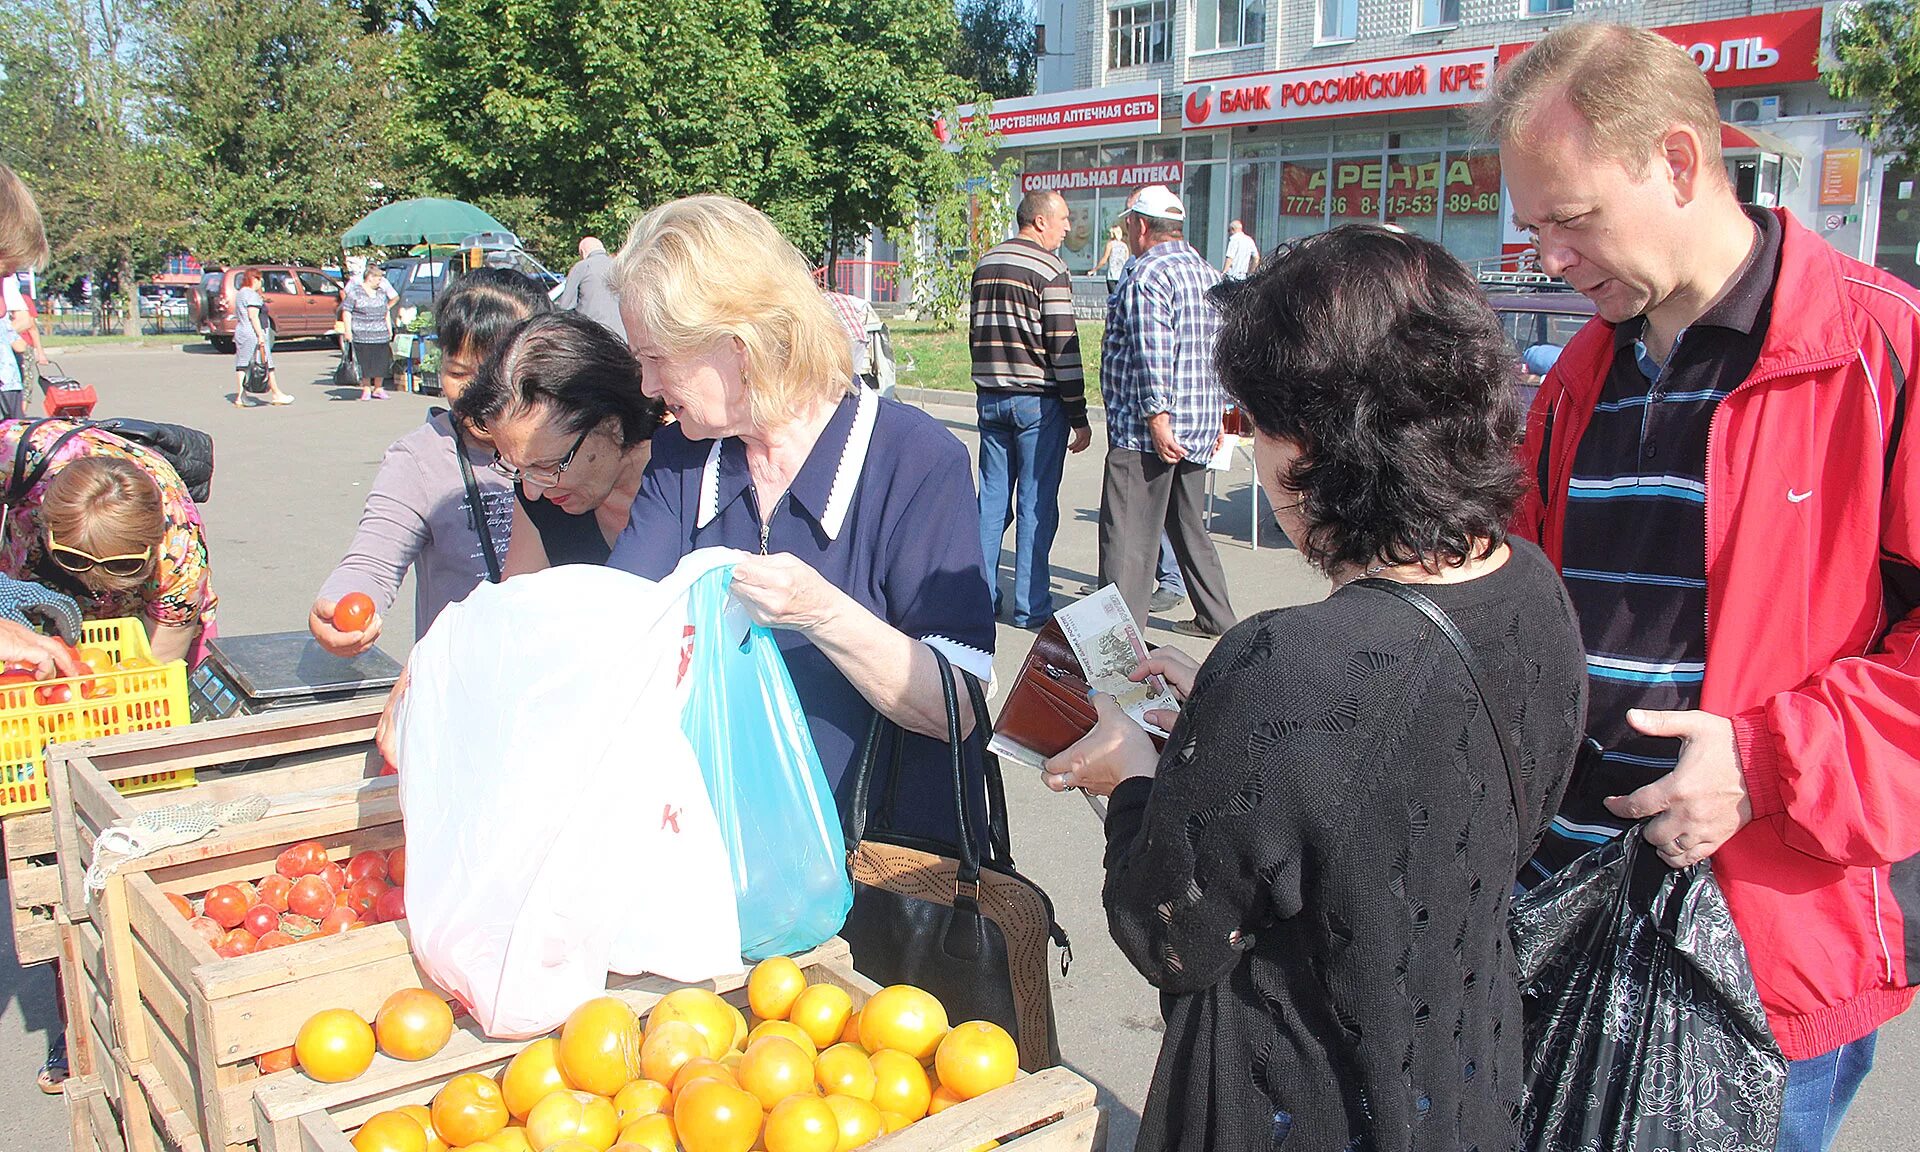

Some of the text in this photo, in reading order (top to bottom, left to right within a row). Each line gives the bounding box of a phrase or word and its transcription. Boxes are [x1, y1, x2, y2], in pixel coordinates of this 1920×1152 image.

[1680, 36, 1779, 74] ОЛЬ
[1220, 85, 1272, 113] БАНК
[1281, 64, 1428, 107] РОССИЙСКИЙ
[1063, 103, 1122, 123] АПТЕЧНАЯ
[1124, 101, 1155, 116] СЕТЬ
[1024, 165, 1181, 191] СОЦИАЛЬНАЯ АПТЕКА
[1308, 160, 1473, 191] АРЕНДА
